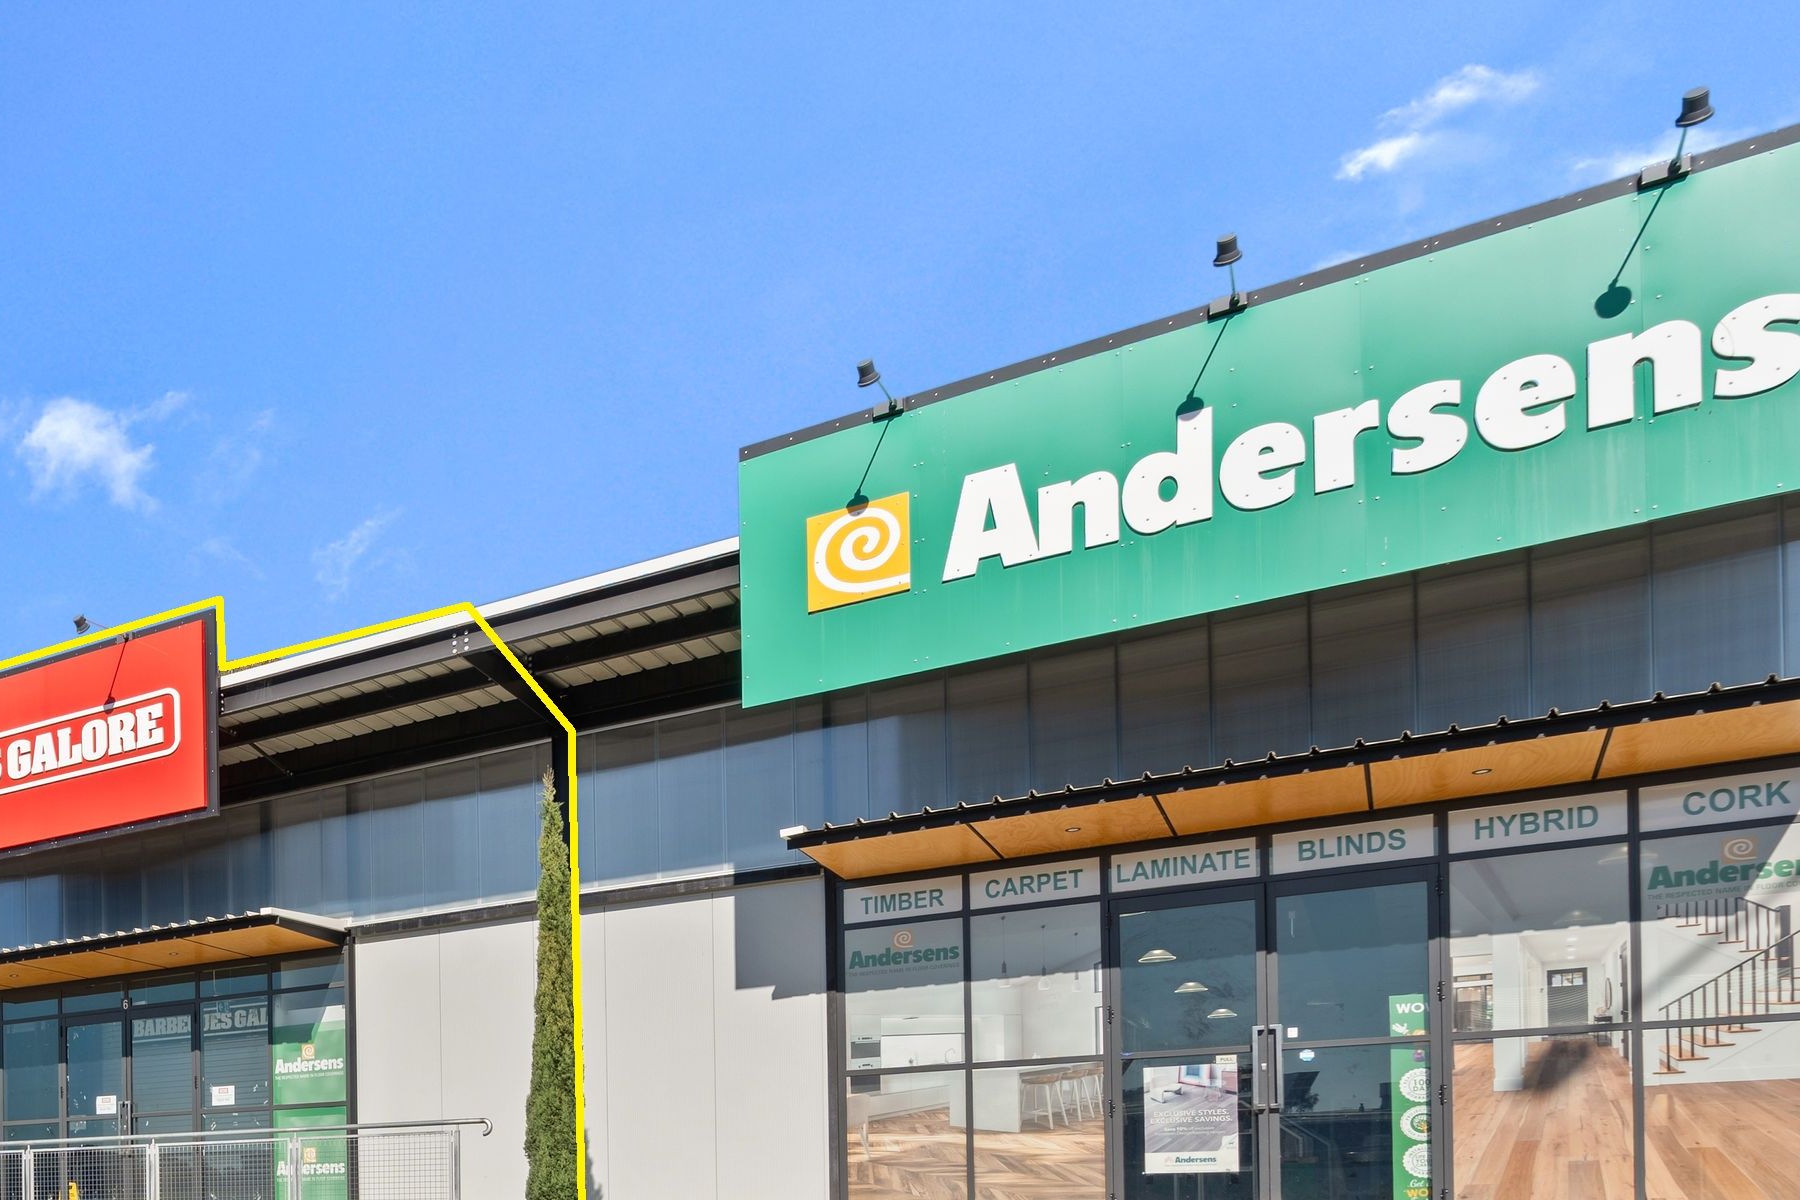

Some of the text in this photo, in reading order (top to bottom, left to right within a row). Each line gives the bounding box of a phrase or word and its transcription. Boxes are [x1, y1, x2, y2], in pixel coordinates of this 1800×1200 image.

[941, 293, 1800, 583] Andersens
[7, 702, 165, 779] GALORE
[1682, 779, 1792, 816] CORK
[1473, 805, 1599, 841] HYBRID
[1297, 828, 1407, 862] BLINDS
[1116, 848, 1250, 883] LAMINATE
[1647, 858, 1800, 890] Anderse
[984, 868, 1083, 899] CARPET
[1648, 893, 1663, 901] THE
[1665, 887, 1713, 899] RESPECTED
[1715, 886, 1738, 895] NAME
[1755, 881, 1784, 890] FLOOR
[860, 888, 944, 915] TIMBER
[848, 945, 960, 970] Andersens
[122, 1000, 129, 1010] 6
[275, 1056, 344, 1074] Andersens
[1150, 1114, 1233, 1125] EXCLUSIVE SAVINGS.
[1153, 1108, 1230, 1118] EXCLUSIVE STYLES.
[276, 1160, 346, 1177] Anersens
[1175, 1155, 1217, 1164] Andersens
[1405, 1187, 1430, 1198] WO
